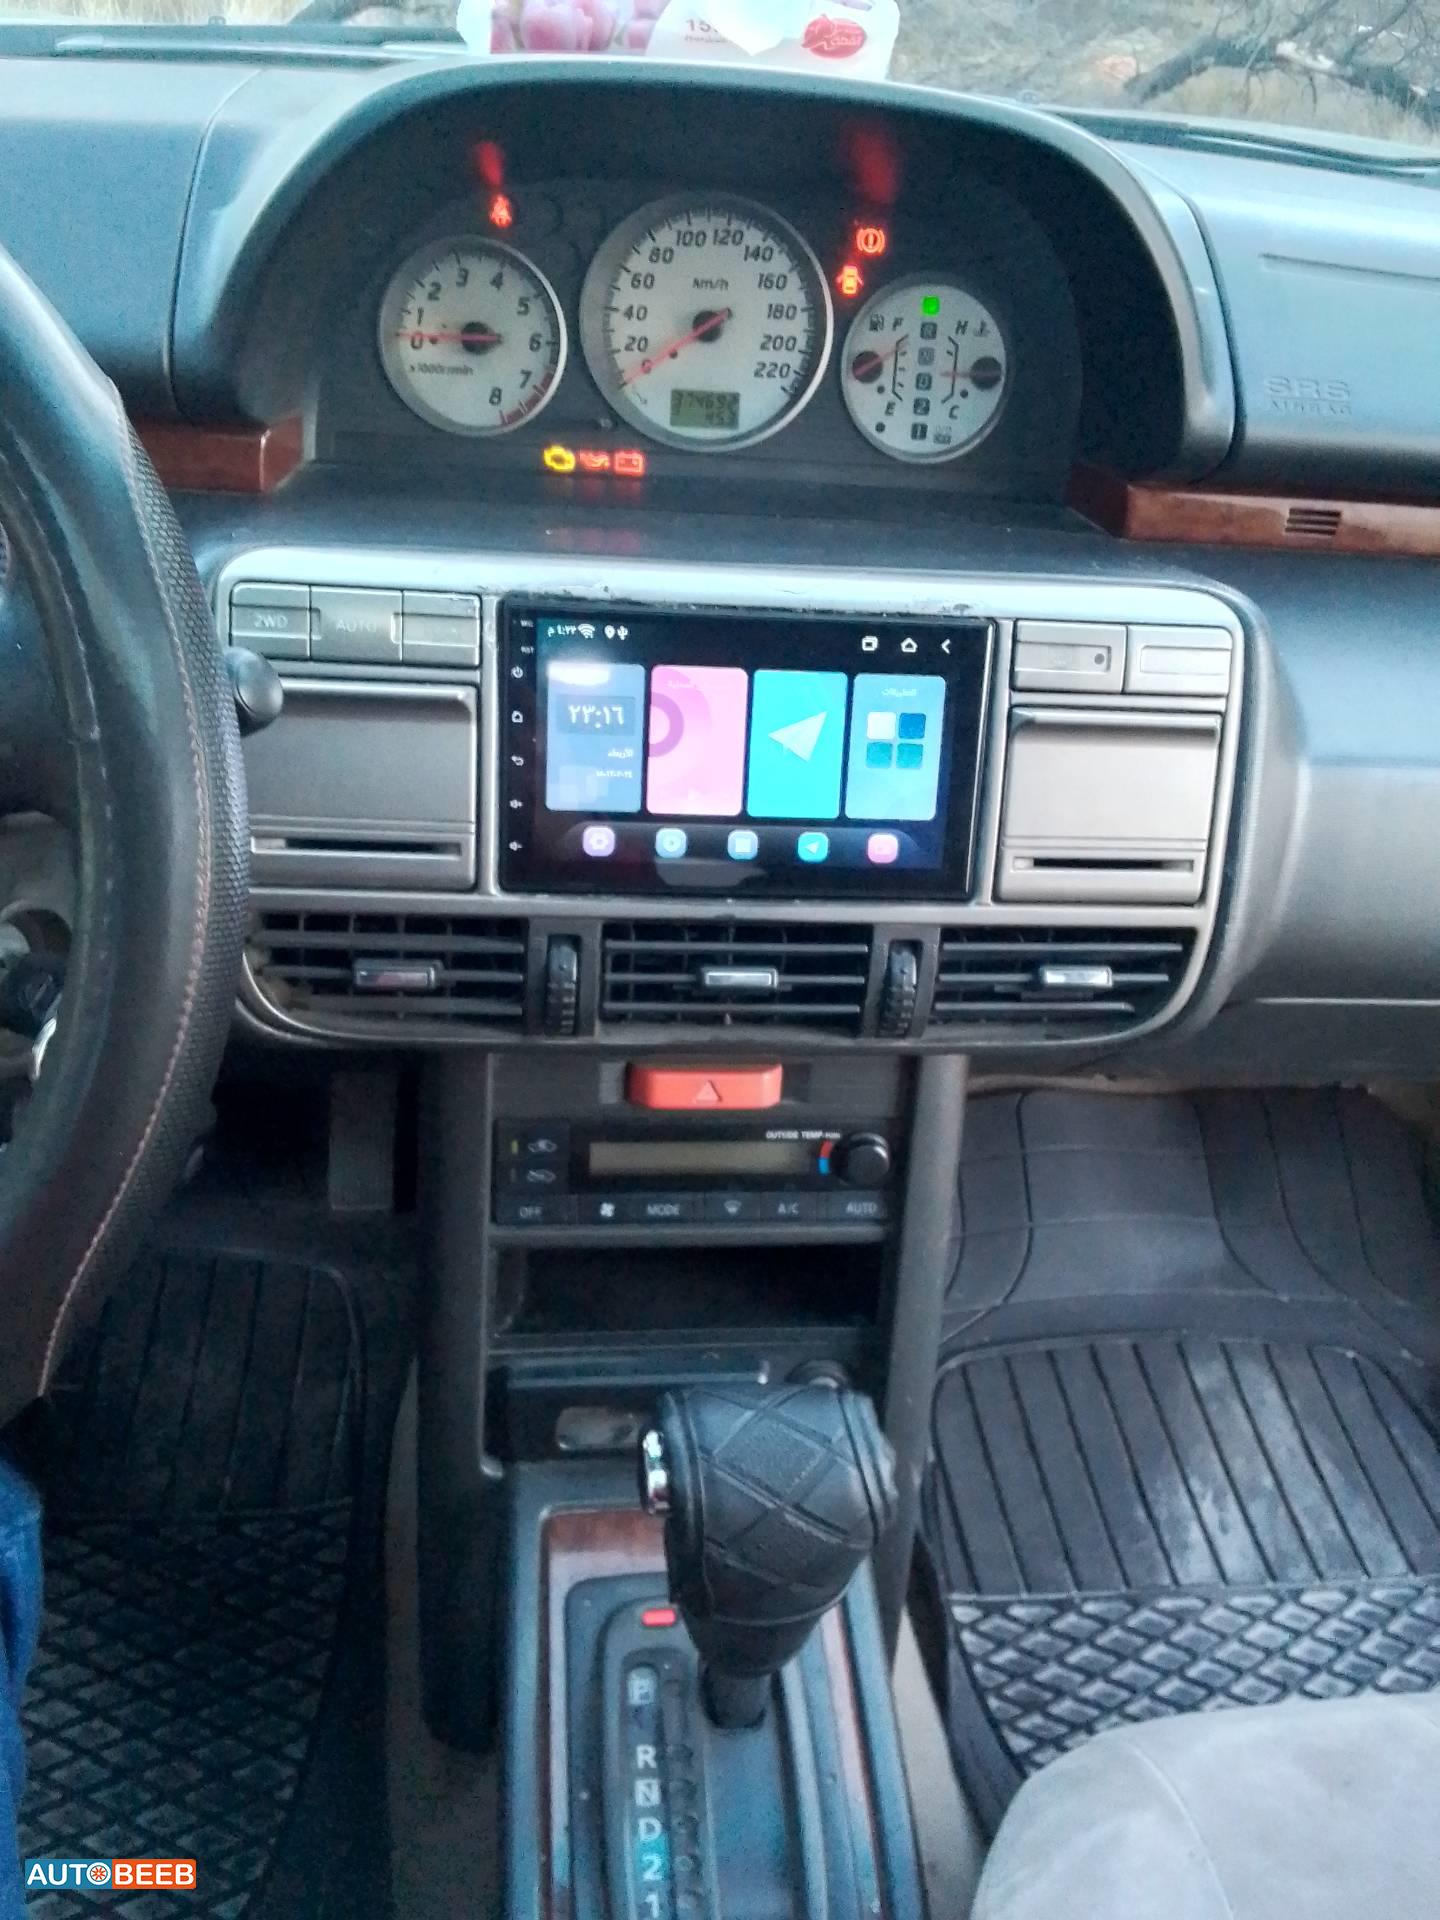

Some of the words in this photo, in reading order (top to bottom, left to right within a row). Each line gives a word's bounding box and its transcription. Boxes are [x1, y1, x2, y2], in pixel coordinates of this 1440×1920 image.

[676, 229, 707, 247] 100
[712, 228, 744, 246] 120
[648, 247, 674, 264] 80
[743, 245, 774, 262] 140
[456, 267, 469, 287] 3
[489, 272, 504, 290] 4
[630, 273, 655, 290] 60
[757, 273, 788, 290] 160
[427, 282, 441, 301] 2
[516, 297, 530, 316] 5
[623, 305, 648, 321] 40
[766, 304, 797, 320] 180
[529, 333, 542, 352] 6
[624, 336, 648, 352] 20
[759, 335, 796, 351] 200
[519, 369, 533, 389] 7
[753, 362, 791, 379] 220
[1266, 376, 1350, 399] SRS
[489, 387, 503, 406] 8
[519, 1205, 542, 1218] OFF
[646, 1203, 681, 1217] MODE
[777, 1202, 801, 1215] A/C
[846, 1202, 878, 1214] AUTO
[636, 1744, 657, 1769] R
[638, 1817, 662, 1842] D
[642, 1853, 663, 1881] 2
